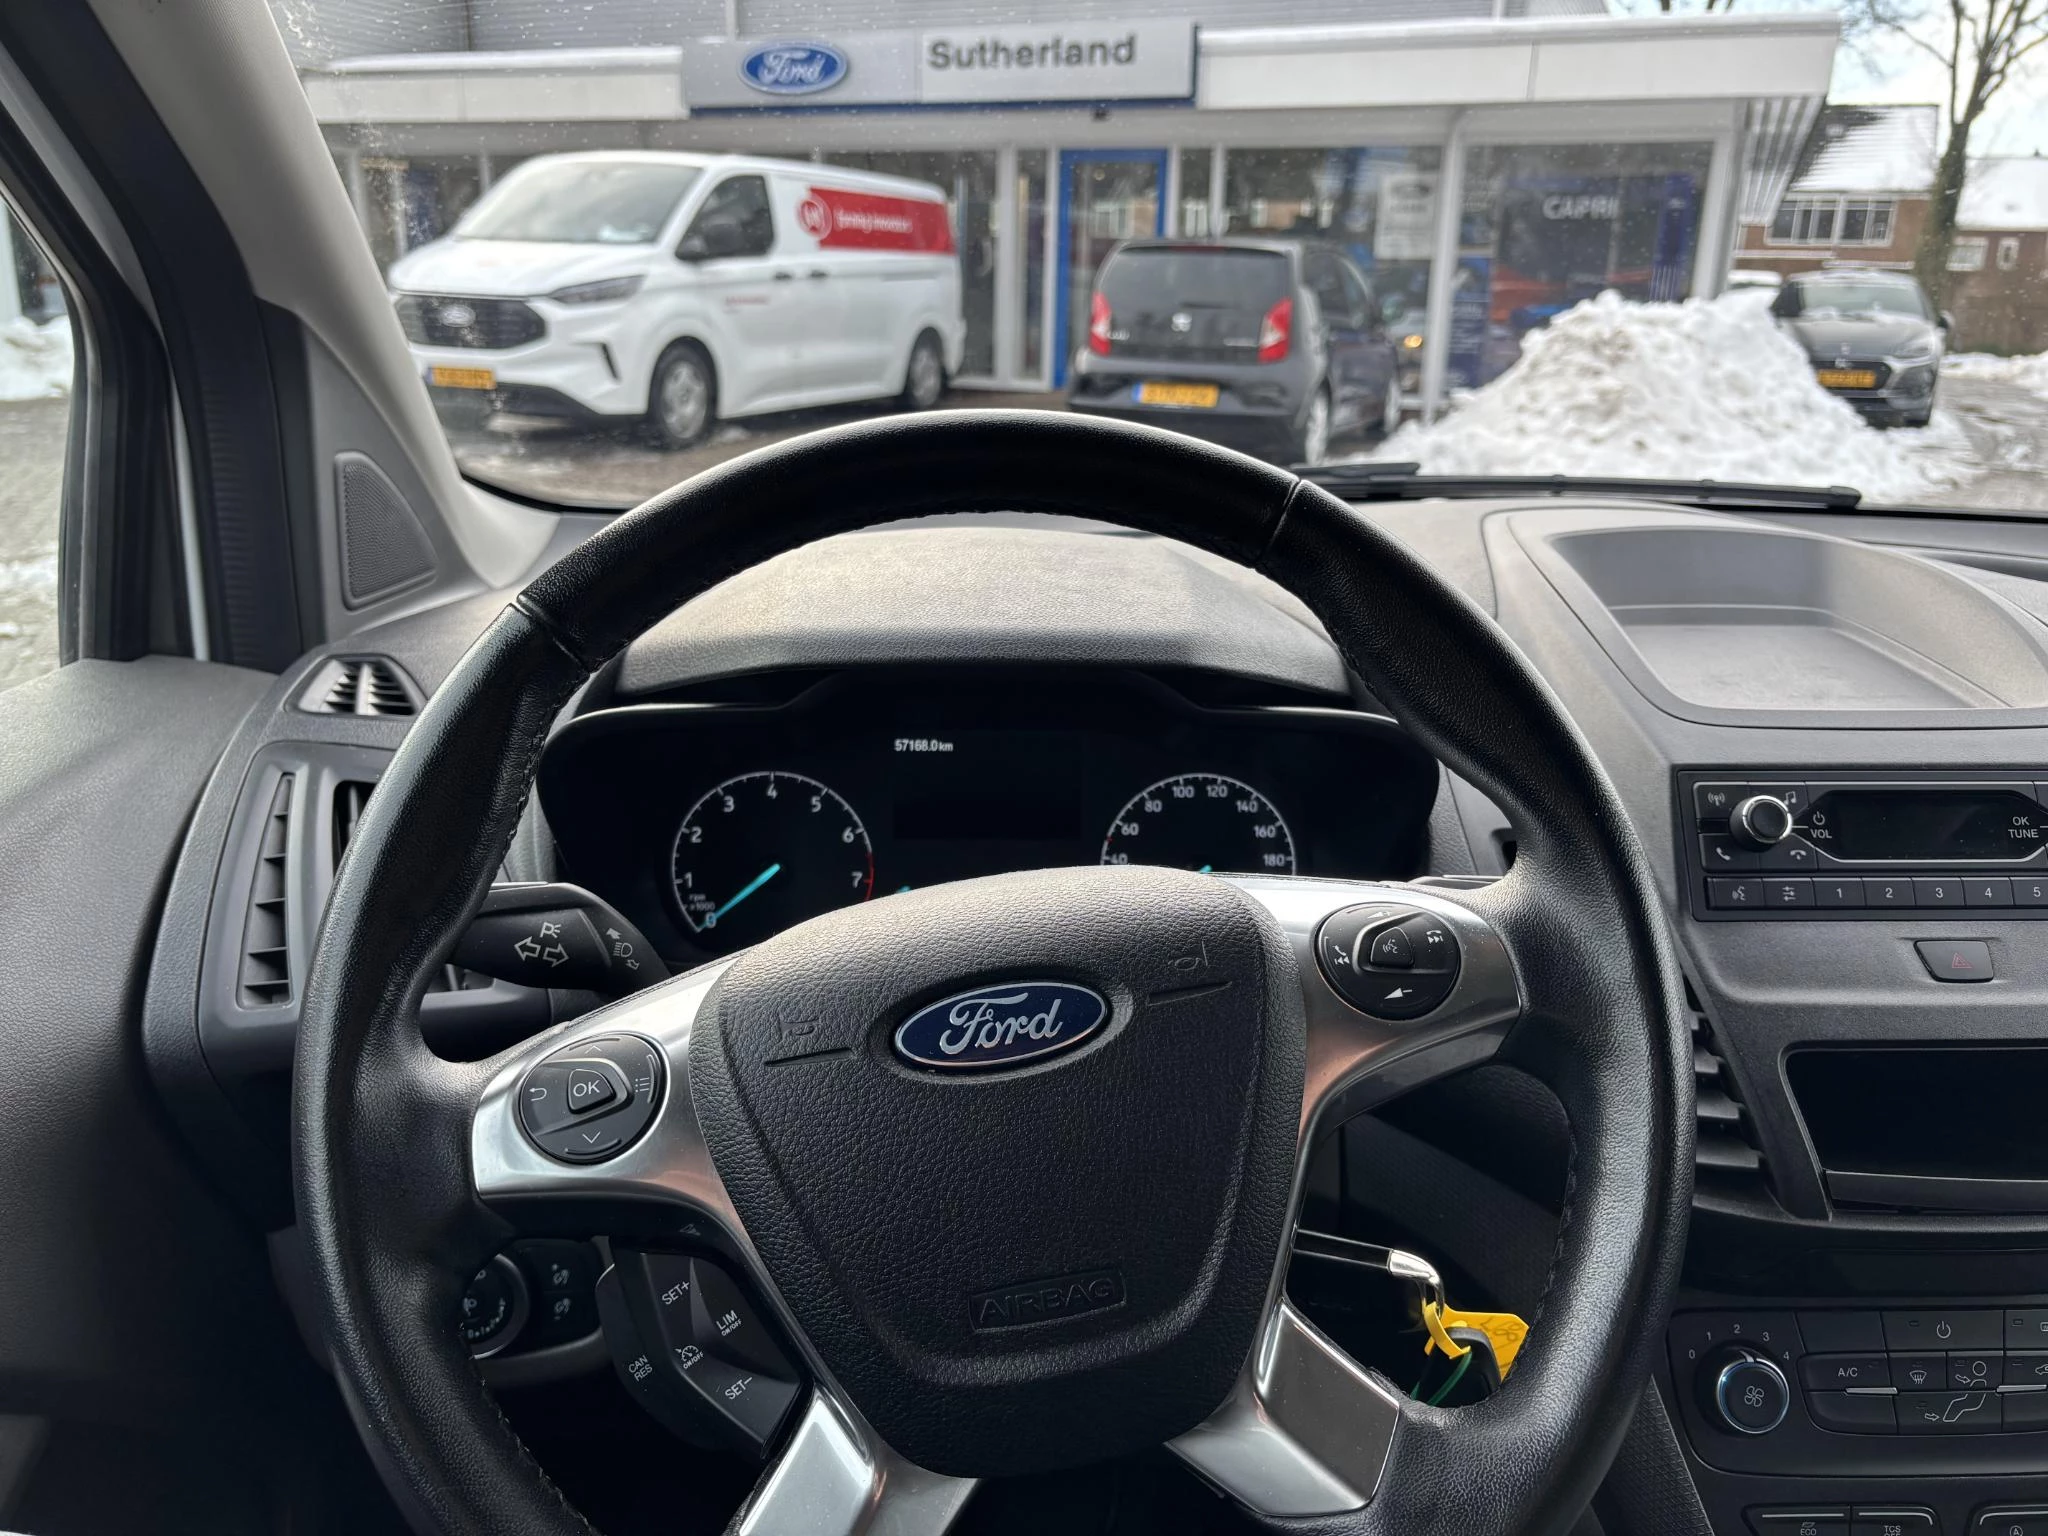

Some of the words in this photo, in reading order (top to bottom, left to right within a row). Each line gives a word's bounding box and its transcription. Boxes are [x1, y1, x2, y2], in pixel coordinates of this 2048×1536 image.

[759, 49, 826, 84] Ford
[928, 34, 1135, 69] Sutherland
[1543, 196, 1620, 220] CAPRI
[767, 785, 778, 798] 4
[1172, 786, 1194, 798] 100
[1206, 785, 1228, 798] 120
[723, 797, 735, 813] 3
[811, 797, 822, 812] 5
[1144, 800, 1162, 813] 80
[1236, 800, 1258, 813] 140
[2012, 816, 2030, 826] OK
[690, 828, 702, 843] 2
[842, 828, 854, 843] 6
[1121, 823, 1139, 836] 60
[1254, 825, 1276, 838] 160
[1811, 829, 1832, 839] VOL
[2008, 828, 2039, 839] TUNE
[1110, 853, 1127, 865] 40
[1263, 854, 1285, 866] 180
[684, 873, 693, 889] 1
[852, 873, 863, 887] 7
[1836, 888, 1843, 899] 1
[1885, 887, 1894, 899] 2
[1935, 887, 1944, 899] 3
[1984, 887, 1993, 898] 4
[2033, 886, 2041, 898] 5
[939, 993, 1063, 1055] Ford
[573, 1080, 600, 1097] OK
[662, 1281, 690, 1305] SET+
[979, 1277, 1115, 1324] AIRBAG
[716, 1310, 738, 1330] LIM
[721, 1319, 743, 1337] ON/OFF
[1733, 1324, 1741, 1334] 2
[1706, 1331, 1712, 1341] 1
[1762, 1331, 1770, 1341] 3
[683, 1351, 704, 1370] ON/OFF
[1688, 1350, 1696, 1360] 0
[1783, 1351, 1790, 1361] 4
[628, 1355, 648, 1373] CAN
[633, 1364, 653, 1382] RES
[1837, 1367, 1858, 1378] A/C
[1800, 1528, 1817, 1536] ECO
[1884, 1525, 1901, 1533] TCS
